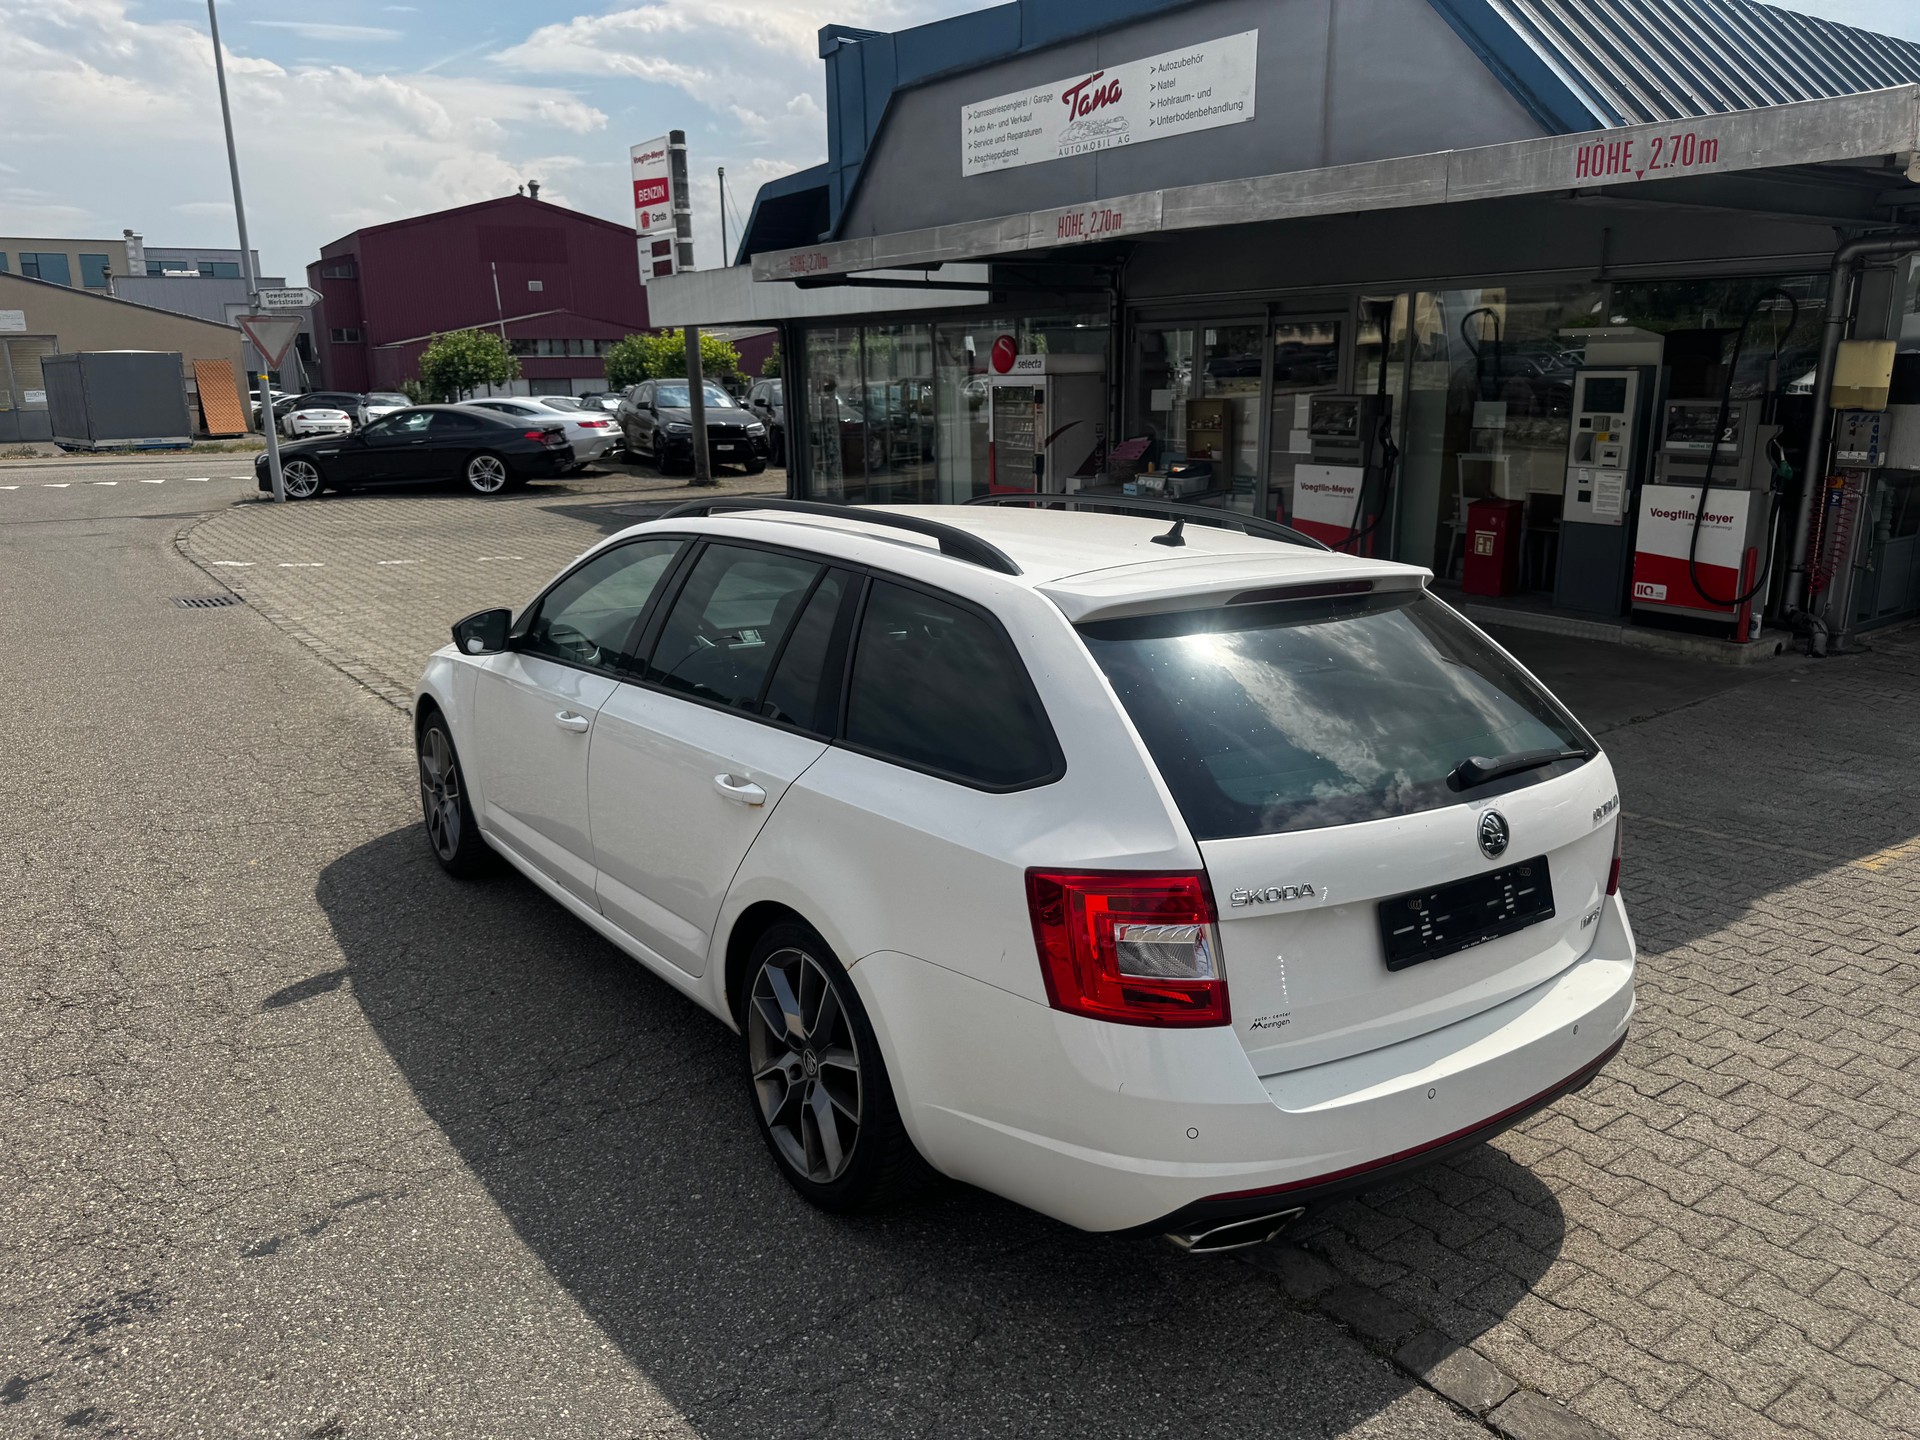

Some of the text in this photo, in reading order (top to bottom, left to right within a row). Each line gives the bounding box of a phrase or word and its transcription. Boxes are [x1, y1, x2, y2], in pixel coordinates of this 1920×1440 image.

[1157, 53, 1204, 73] Autozubehör
[1157, 77, 1176, 91] Natel
[1033, 93, 1054, 104] Garage
[1061, 70, 1123, 122] Tana
[1157, 87, 1212, 108] Hohlraum- und
[973, 125, 986, 134] Auto
[998, 118, 1010, 128] und
[1010, 112, 1033, 125] Verkauf
[1157, 101, 1244, 126] Unterbodenbehandlung
[973, 127, 1043, 149] Service und Reparaturen
[1058, 134, 1130, 156] AUTOMOBIL AG
[973, 147, 1019, 163] Abschleppdienst
[1576, 137, 1634, 179] HÖHE
[638, 184, 665, 202] BENZIN
[652, 212, 667, 222] Cards
[1058, 210, 1084, 239] HÖHE
[1017, 359, 1042, 369] selecta
[1347, 417, 1353, 428] 1
[1721, 427, 1733, 441] 2
[1300, 482, 1355, 494] Voegtlin-Meyer
[1230, 882, 1316, 907] ŠKODA
